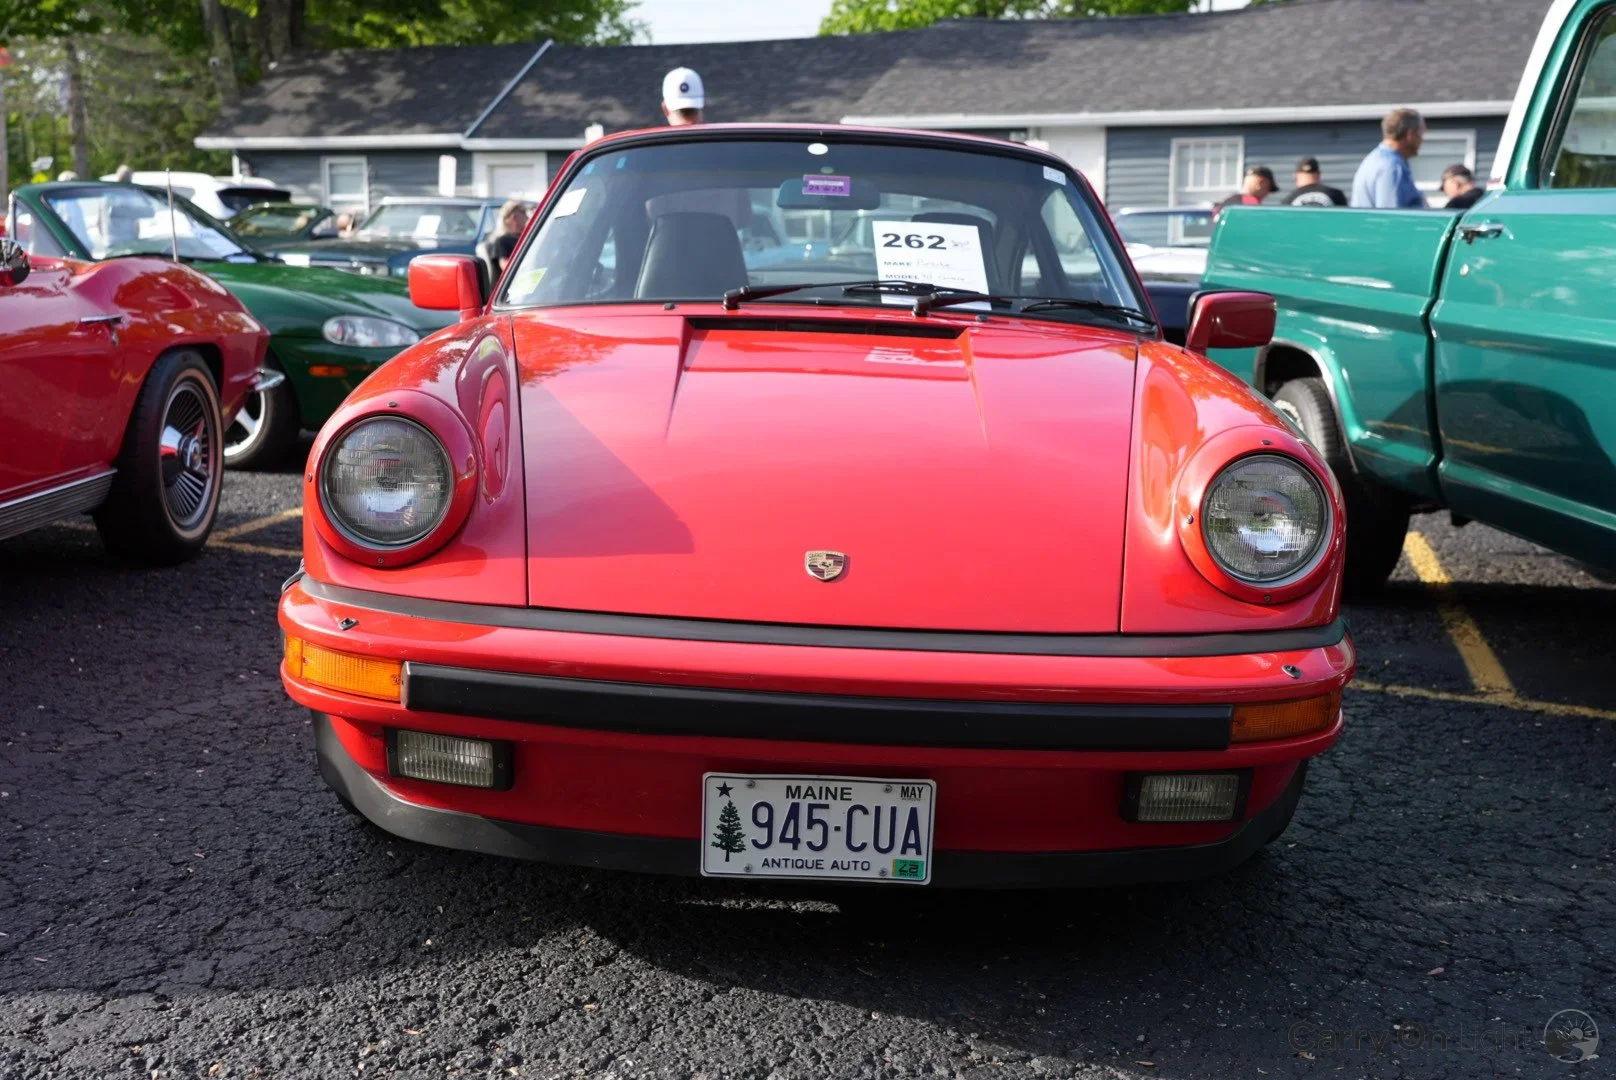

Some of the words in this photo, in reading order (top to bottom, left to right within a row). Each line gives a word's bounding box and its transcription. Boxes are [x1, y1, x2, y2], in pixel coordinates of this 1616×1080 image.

[882, 233, 947, 250] 262
[785, 784, 853, 801] MAINE
[900, 785, 924, 799] MAY
[761, 857, 825, 870] ANTIQUE
[830, 860, 871, 872] AUTO
